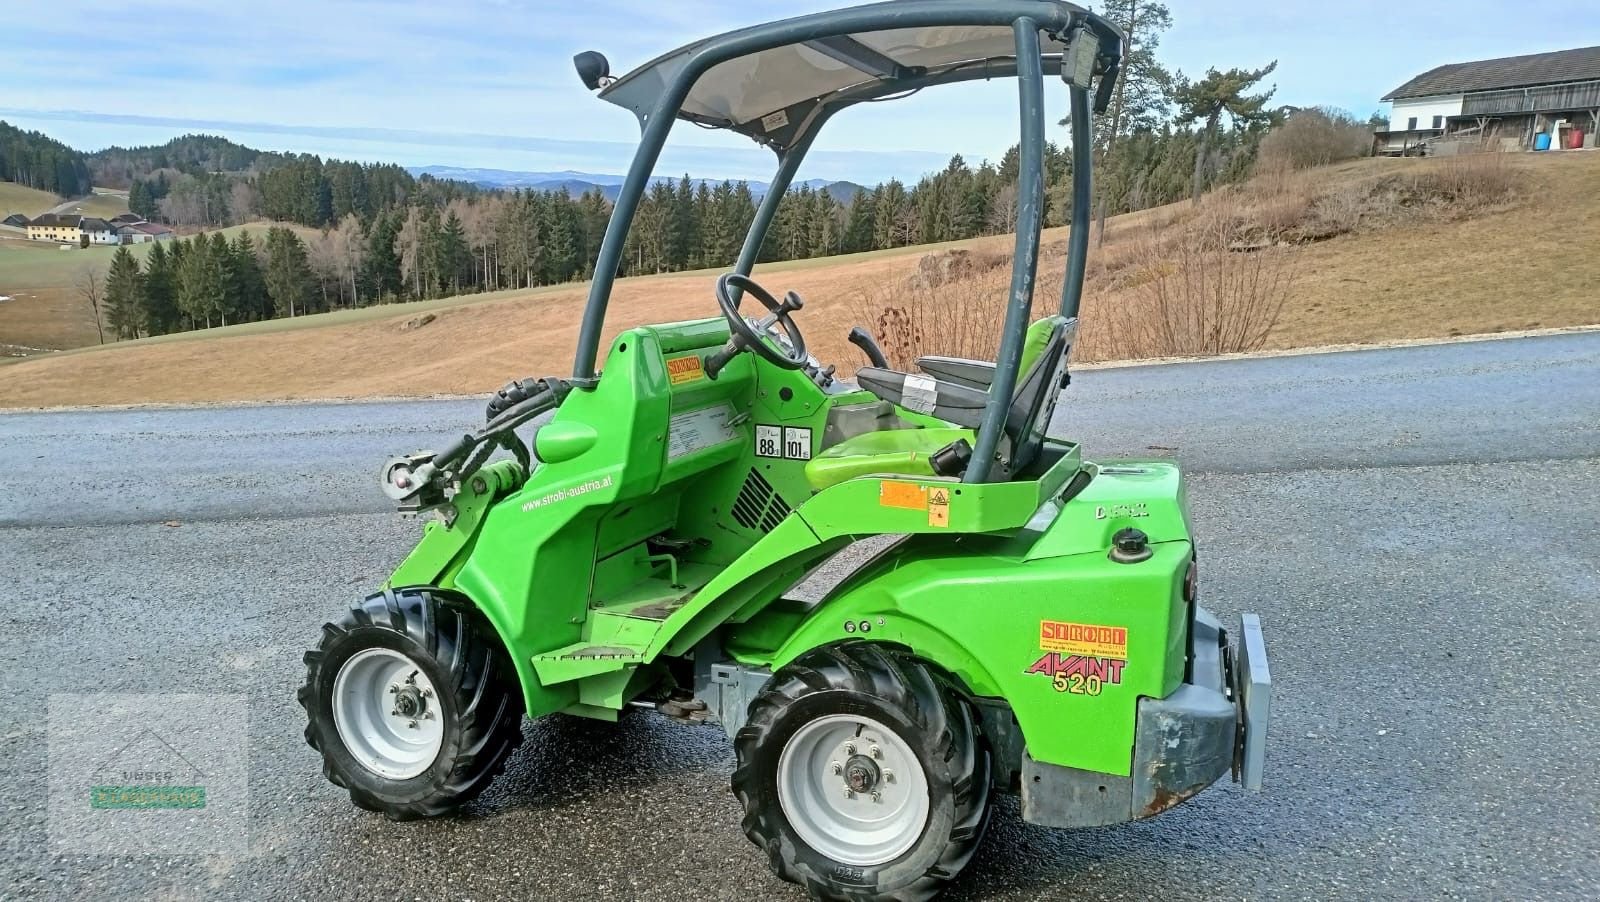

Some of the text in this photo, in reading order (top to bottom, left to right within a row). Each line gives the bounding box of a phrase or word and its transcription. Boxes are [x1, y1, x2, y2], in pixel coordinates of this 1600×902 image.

[760, 438, 775, 456] 88
[787, 441, 802, 458] 101
[521, 474, 613, 513] www.strobl-austria.at
[1042, 622, 1125, 645] STROBL
[1024, 652, 1126, 684] AVANT
[1052, 671, 1102, 697] 520
